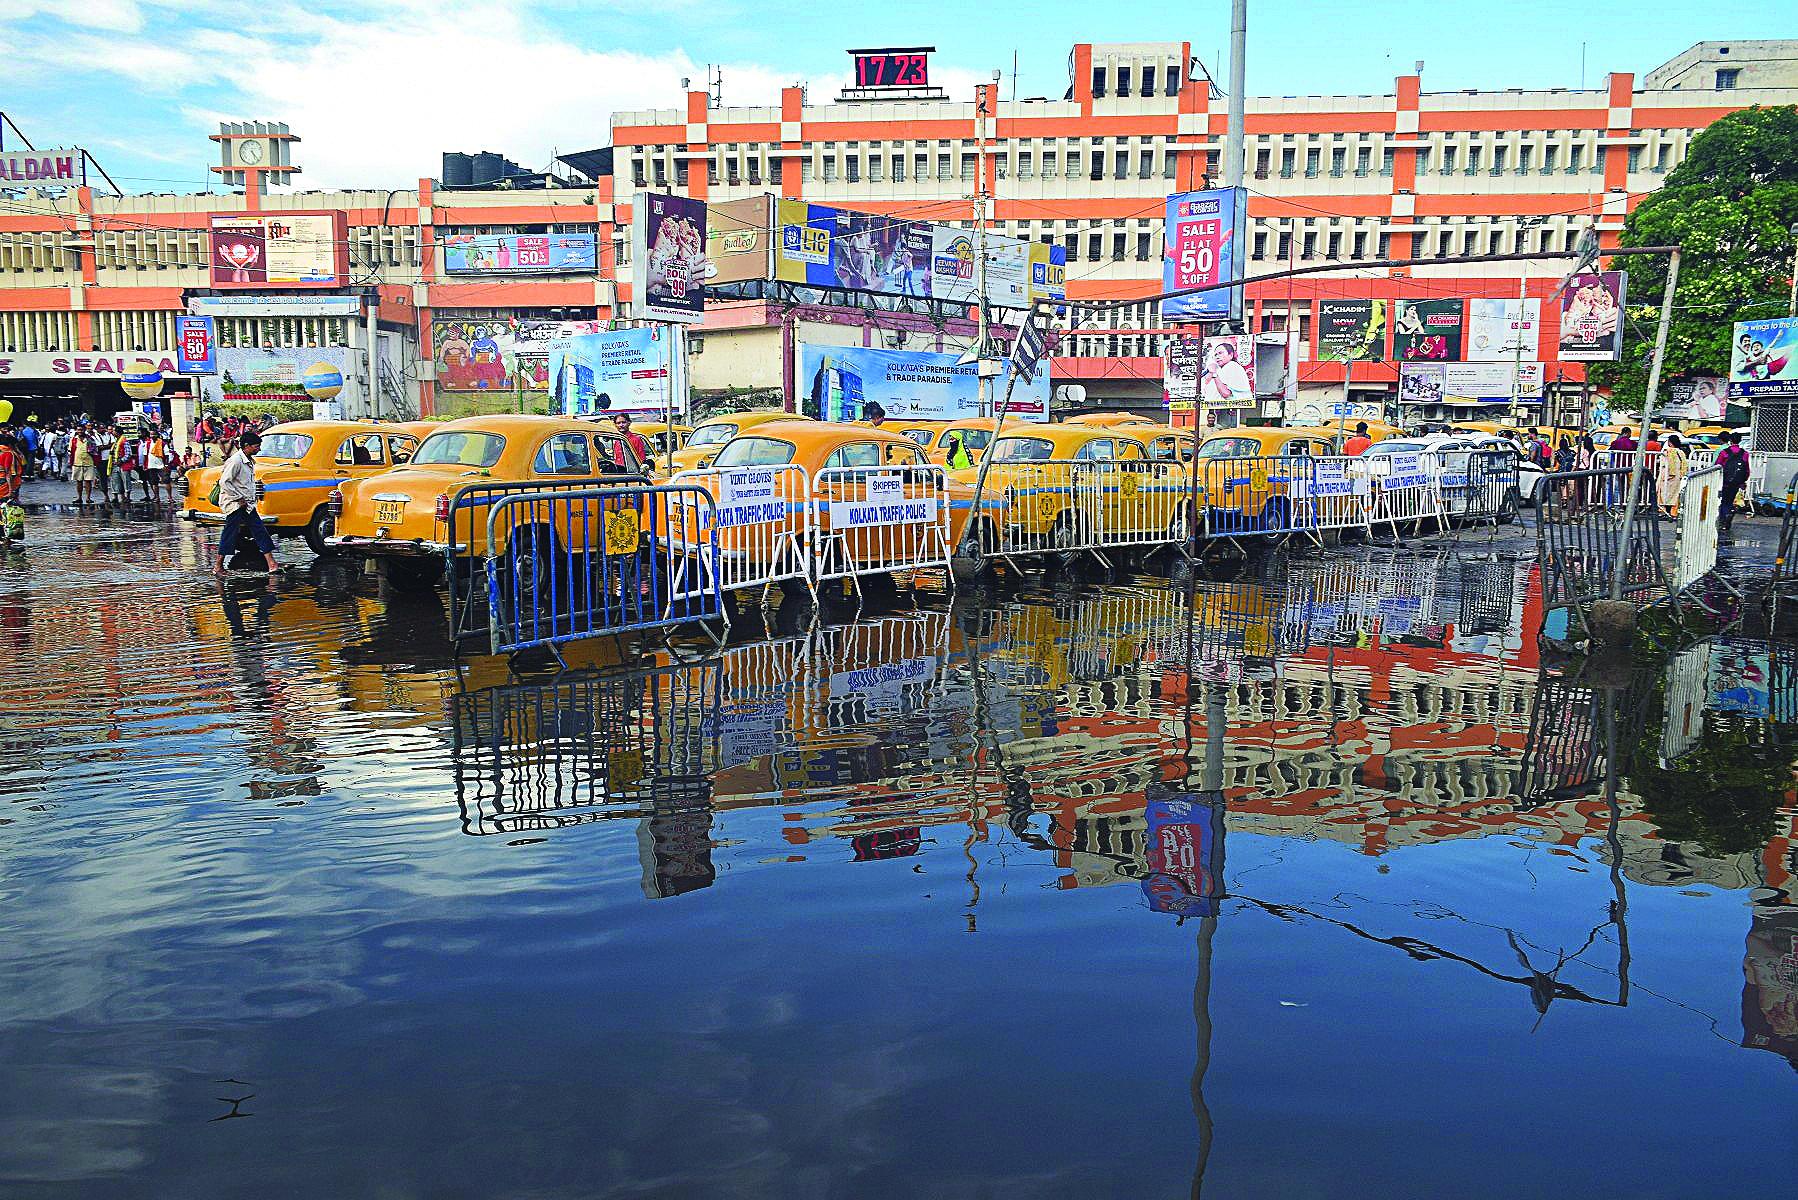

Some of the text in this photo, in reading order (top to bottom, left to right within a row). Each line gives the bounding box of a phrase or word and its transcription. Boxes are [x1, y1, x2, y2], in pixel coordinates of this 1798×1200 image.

[859, 56, 926, 86] 17 23
[1182, 223, 1215, 236] SALE
[803, 231, 826, 253] LIC
[1184, 240, 1212, 250] FLAT
[520, 251, 538, 264] 50
[1180, 248, 1214, 274] 50
[666, 269, 687, 281] ROLL
[1047, 266, 1064, 284] LIC
[672, 279, 685, 296] 99
[1583, 331, 1595, 341] 99
[187, 342, 205, 354] 50
[887, 363, 978, 376] KOLKATA'S PREMIERE RETAI
[893, 374, 916, 382] TRADE
[872, 480, 900, 490] SKIPPER
[735, 505, 762, 525] TRAFFIC
[763, 502, 784, 521] POLICE
[849, 503, 927, 524] KOLKATA TRAFFIC POLICE
